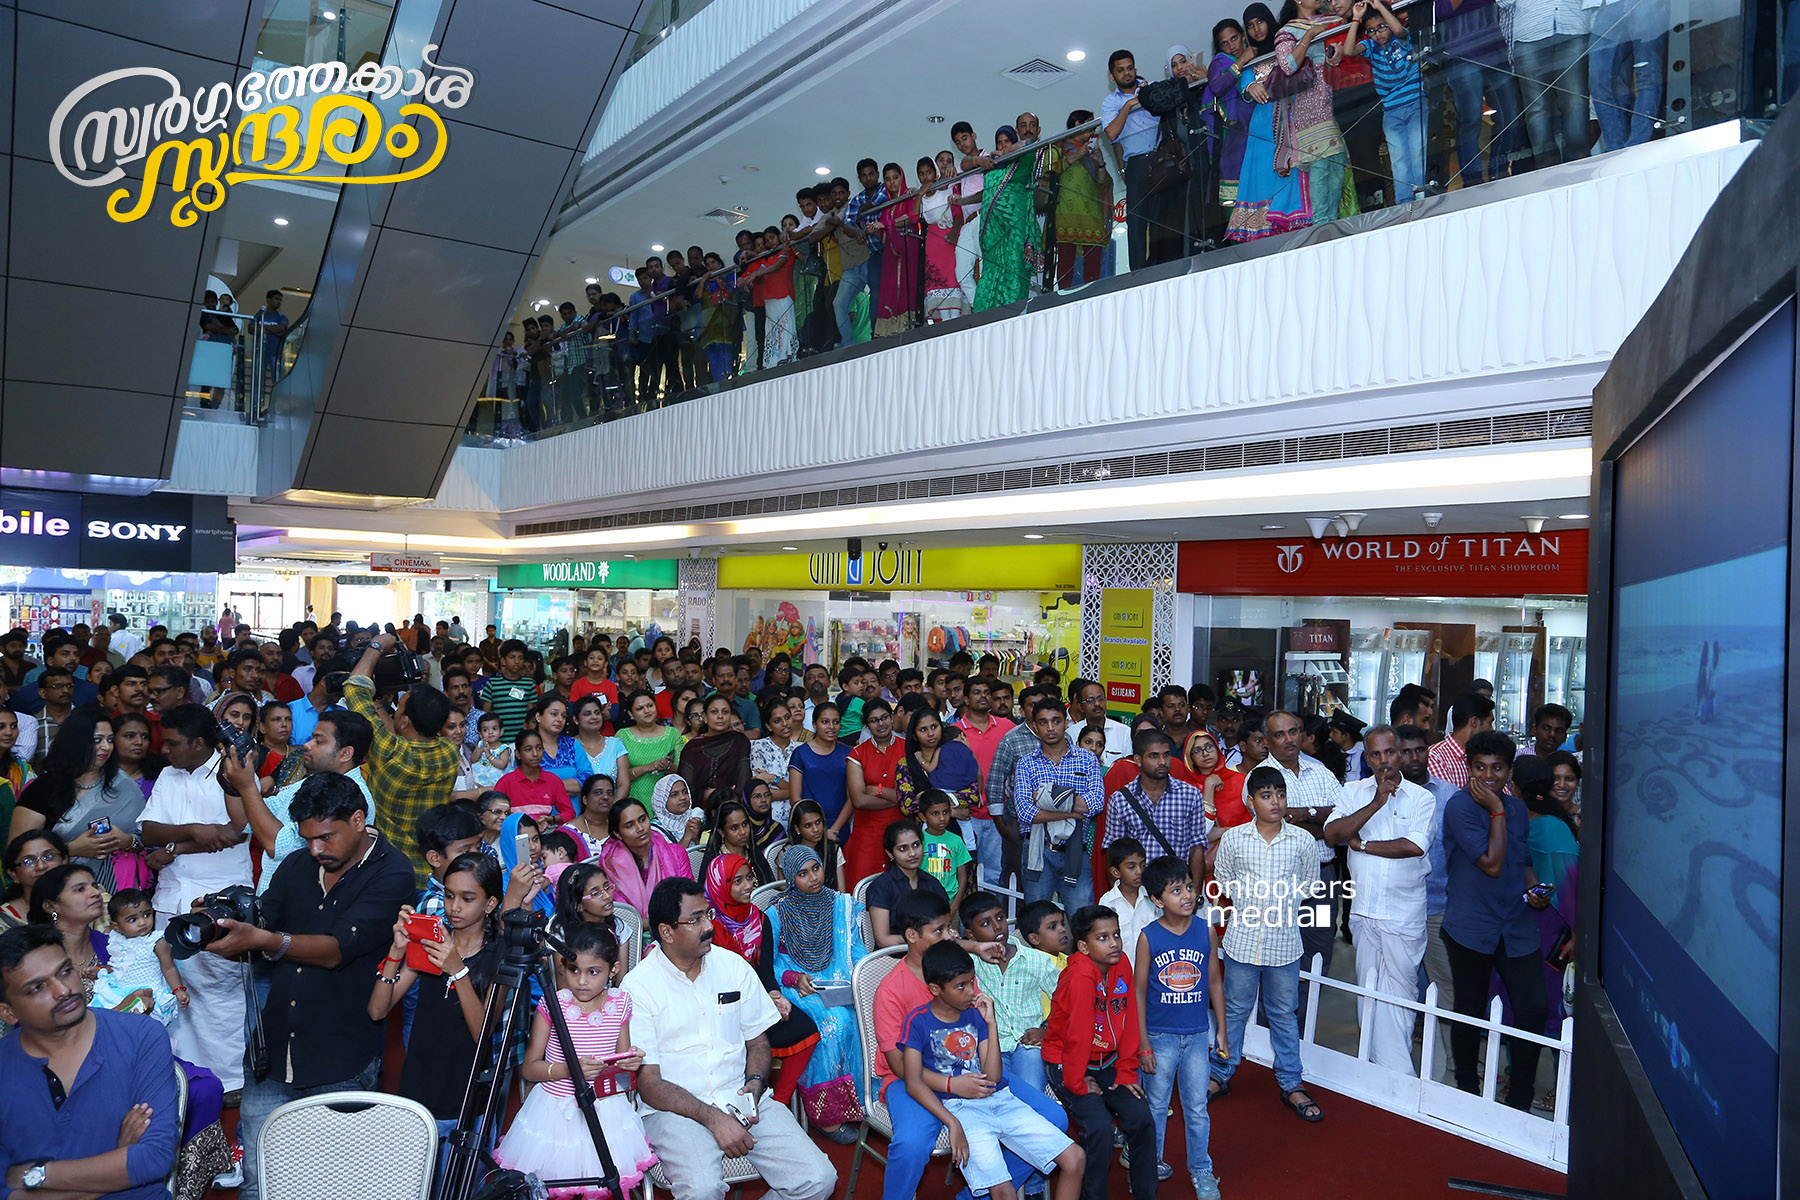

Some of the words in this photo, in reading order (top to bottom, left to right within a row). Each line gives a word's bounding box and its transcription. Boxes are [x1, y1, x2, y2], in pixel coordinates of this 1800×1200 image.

[87, 520, 187, 542] SONY
[194, 528, 234, 536] smartphone
[1321, 541, 1421, 560] WORLD
[1428, 535, 1451, 561] of
[1458, 536, 1560, 558] TITAN
[394, 558, 431, 568] CINEMAX
[1394, 564, 1412, 573] THE
[1415, 564, 1466, 573] EXCLUSIVE
[1469, 563, 1498, 572] TITAN
[1501, 562, 1561, 572] SHOWROOM
[542, 561, 596, 582] WOODLAND
[687, 596, 707, 606] RADO
[1103, 635, 1122, 645] Brands
[1122, 636, 1149, 647] Available
[1309, 633, 1334, 644] TITAN
[1154, 950, 1176, 968] HOT
[1178, 948, 1205, 965] SHOT
[1160, 991, 1203, 1004] ATHLETE
